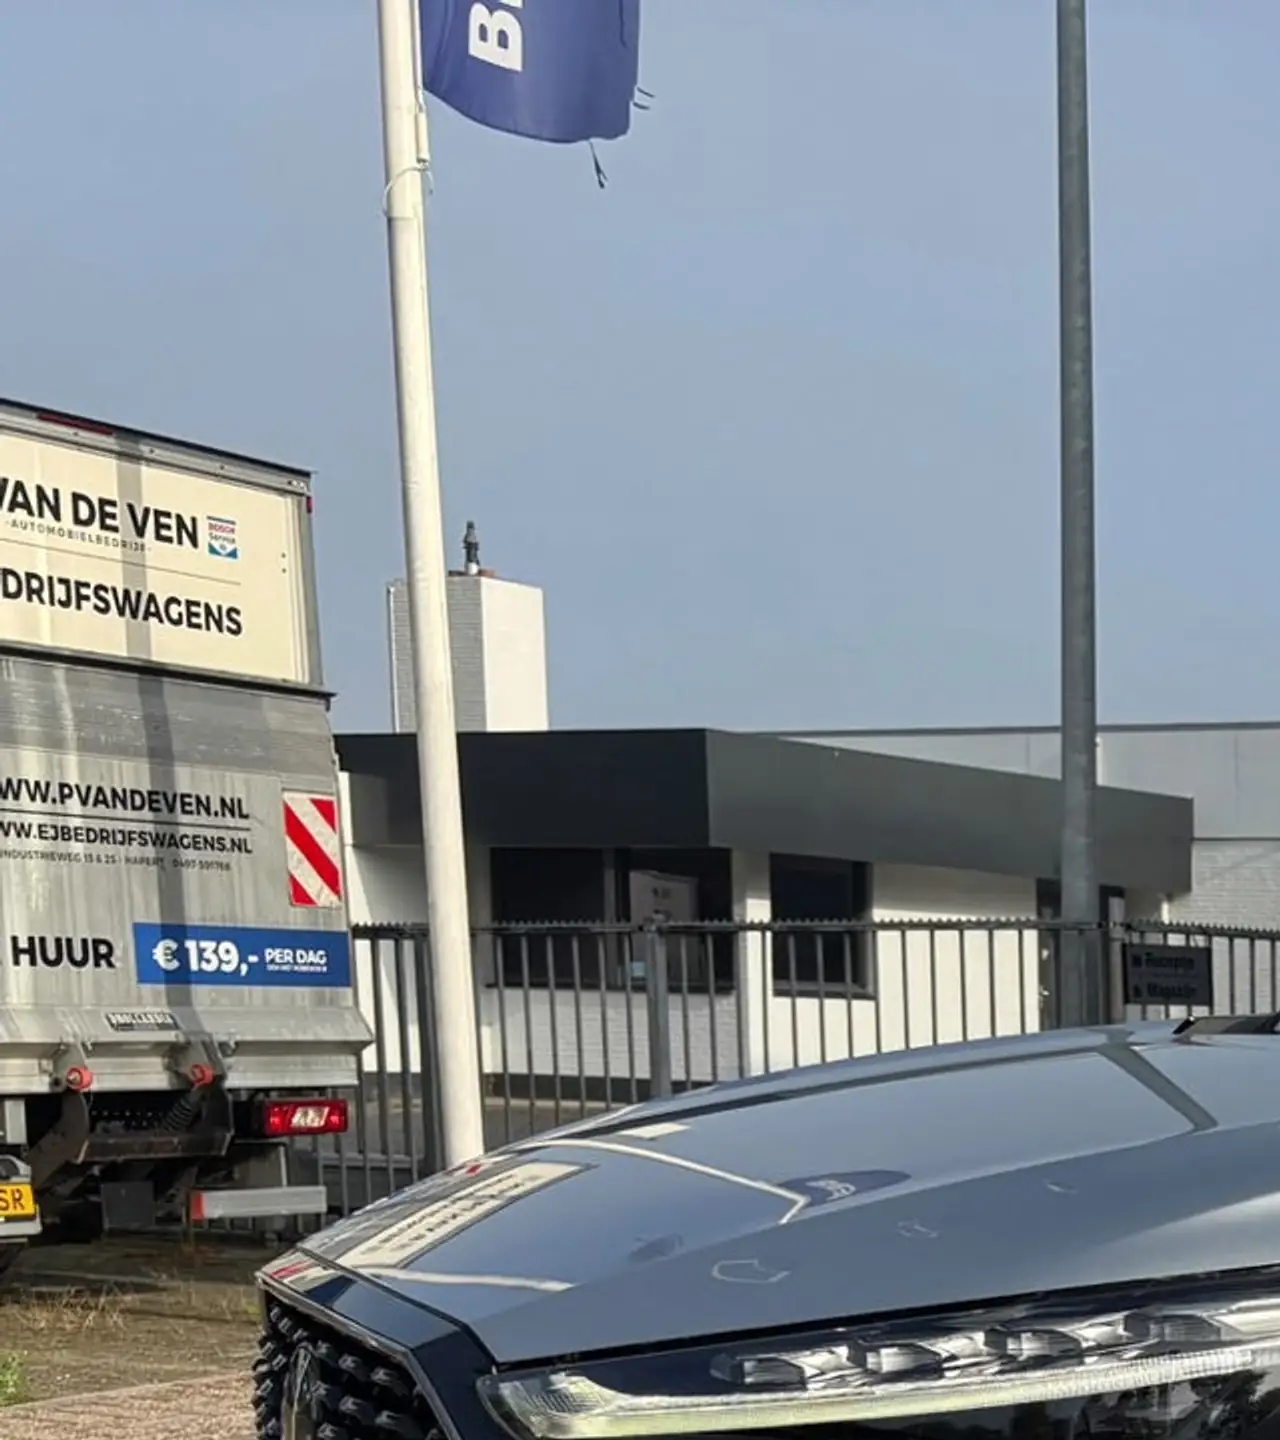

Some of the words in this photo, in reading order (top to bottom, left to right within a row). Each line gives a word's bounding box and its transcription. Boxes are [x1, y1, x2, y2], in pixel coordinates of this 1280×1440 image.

[468, 0, 524, 72] B
[71, 491, 119, 533] DE
[126, 502, 199, 549] VEN
[0, 567, 243, 636] DRIJFSWAGENS
[11, 935, 115, 968] HUUR
[264, 948, 294, 963] PER
[296, 949, 327, 964] DAG
